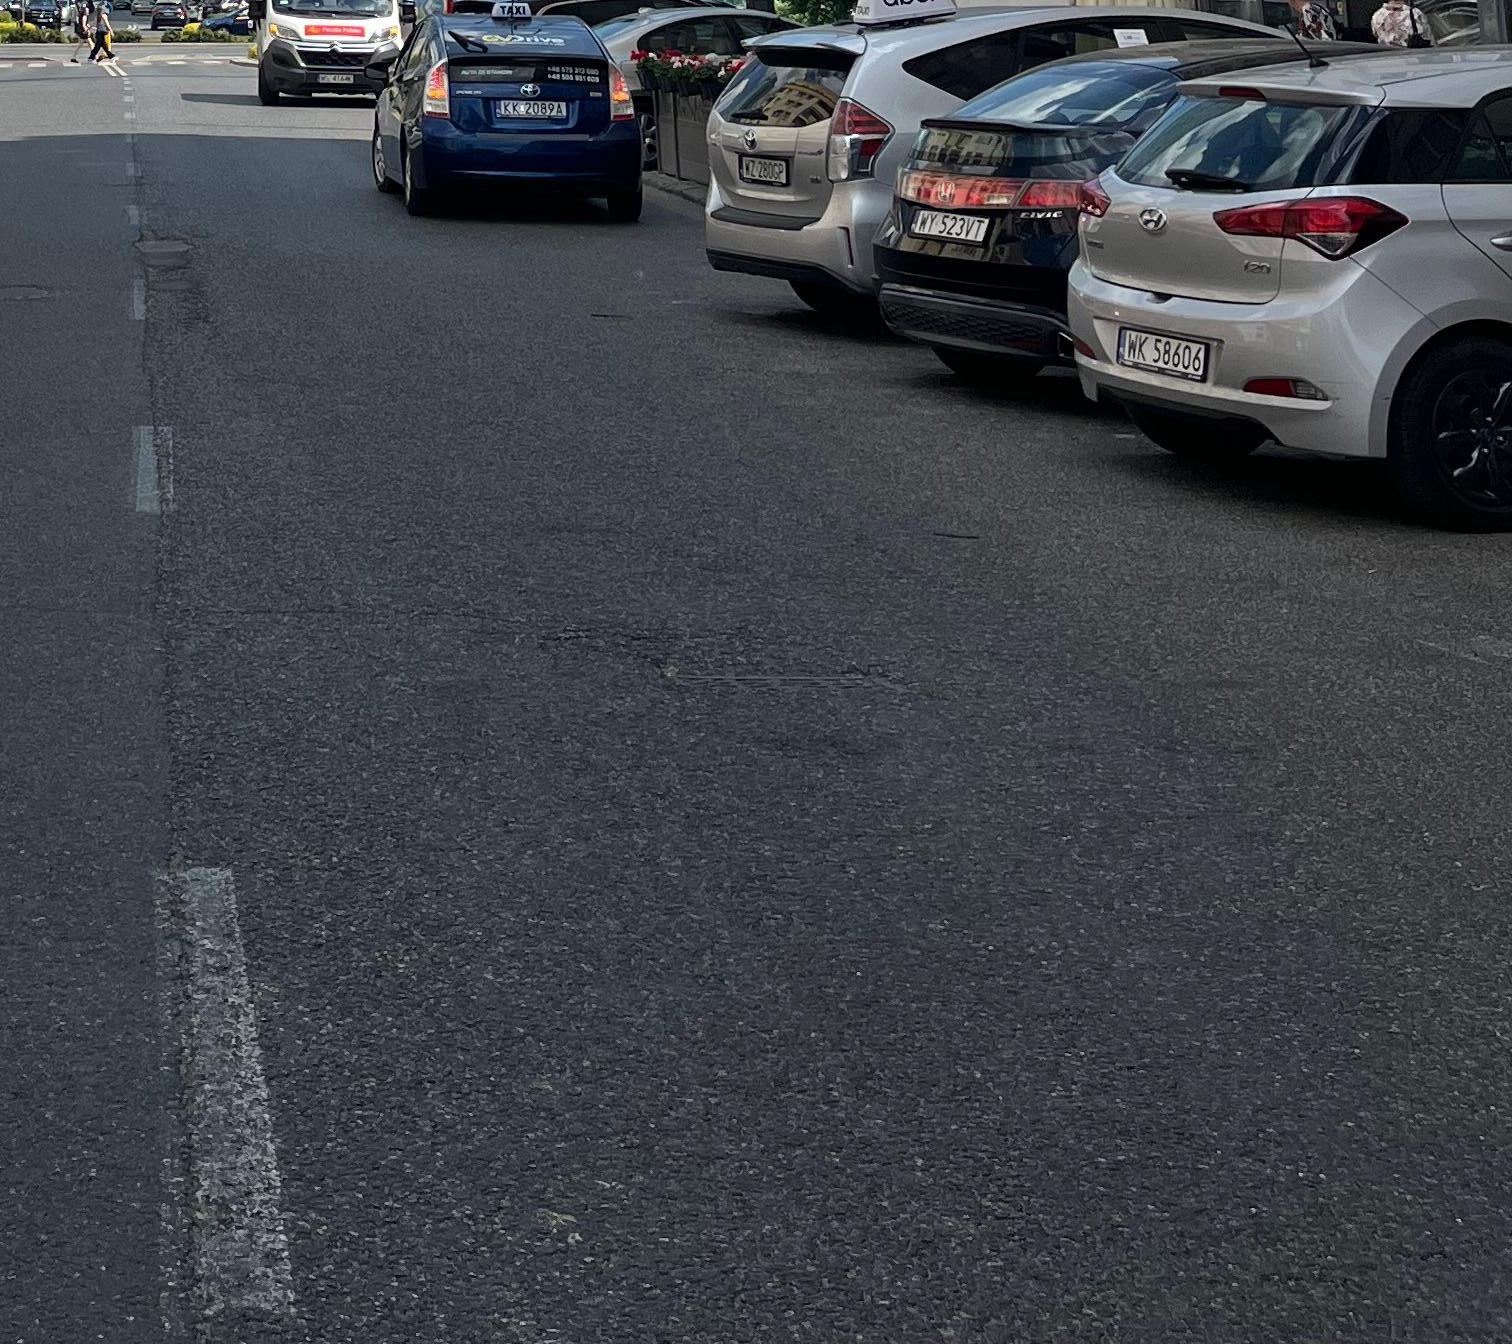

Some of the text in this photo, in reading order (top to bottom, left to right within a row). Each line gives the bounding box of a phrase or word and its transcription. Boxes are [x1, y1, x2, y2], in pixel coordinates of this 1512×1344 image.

[499, 2, 527, 15] TAXI
[503, 101, 563, 116] KK 2089A
[744, 159, 756, 178] WZ
[1020, 210, 1063, 219] CIVIC
[918, 211, 985, 241] WY 523VT
[1244, 259, 1272, 275] i20
[1128, 331, 1203, 373] WK 58606
